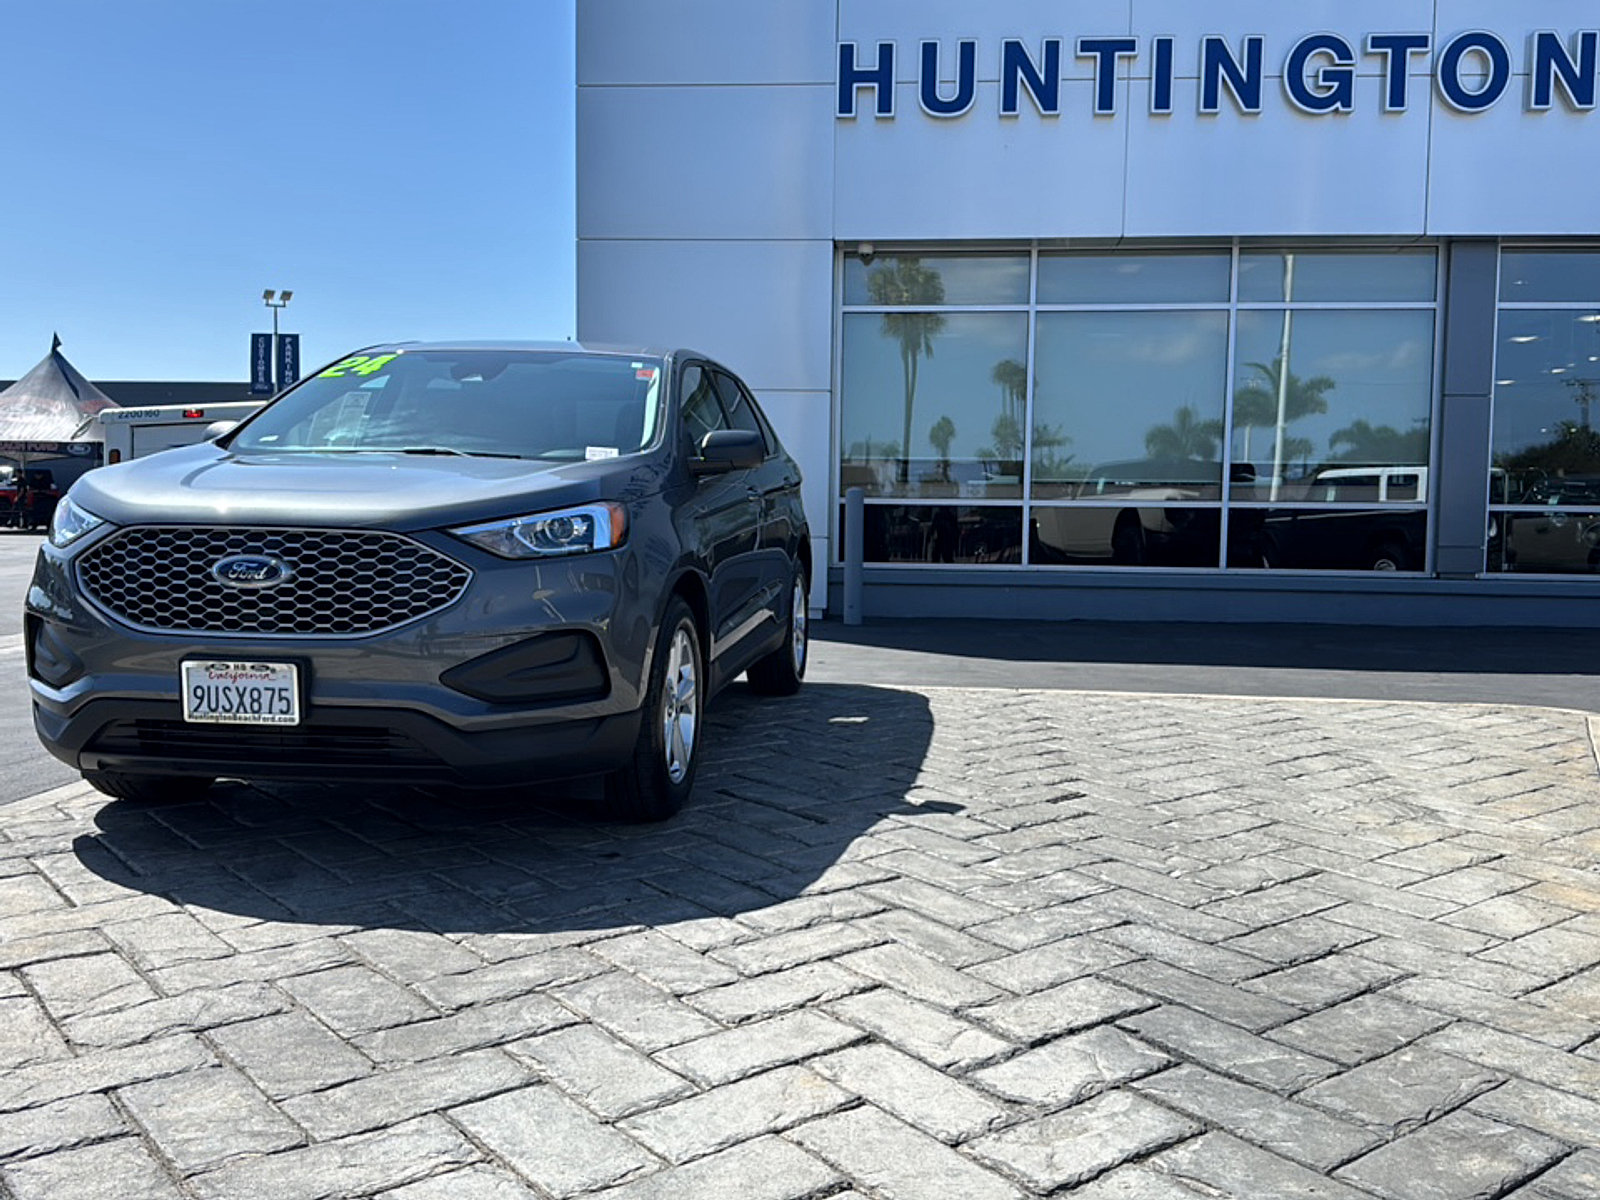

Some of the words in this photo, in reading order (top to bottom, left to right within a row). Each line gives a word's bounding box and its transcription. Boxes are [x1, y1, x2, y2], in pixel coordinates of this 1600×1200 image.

[835, 28, 1599, 119] HUNTINGTON
[284, 336, 293, 384] PARKING
[193, 685, 291, 714] 9USX875
